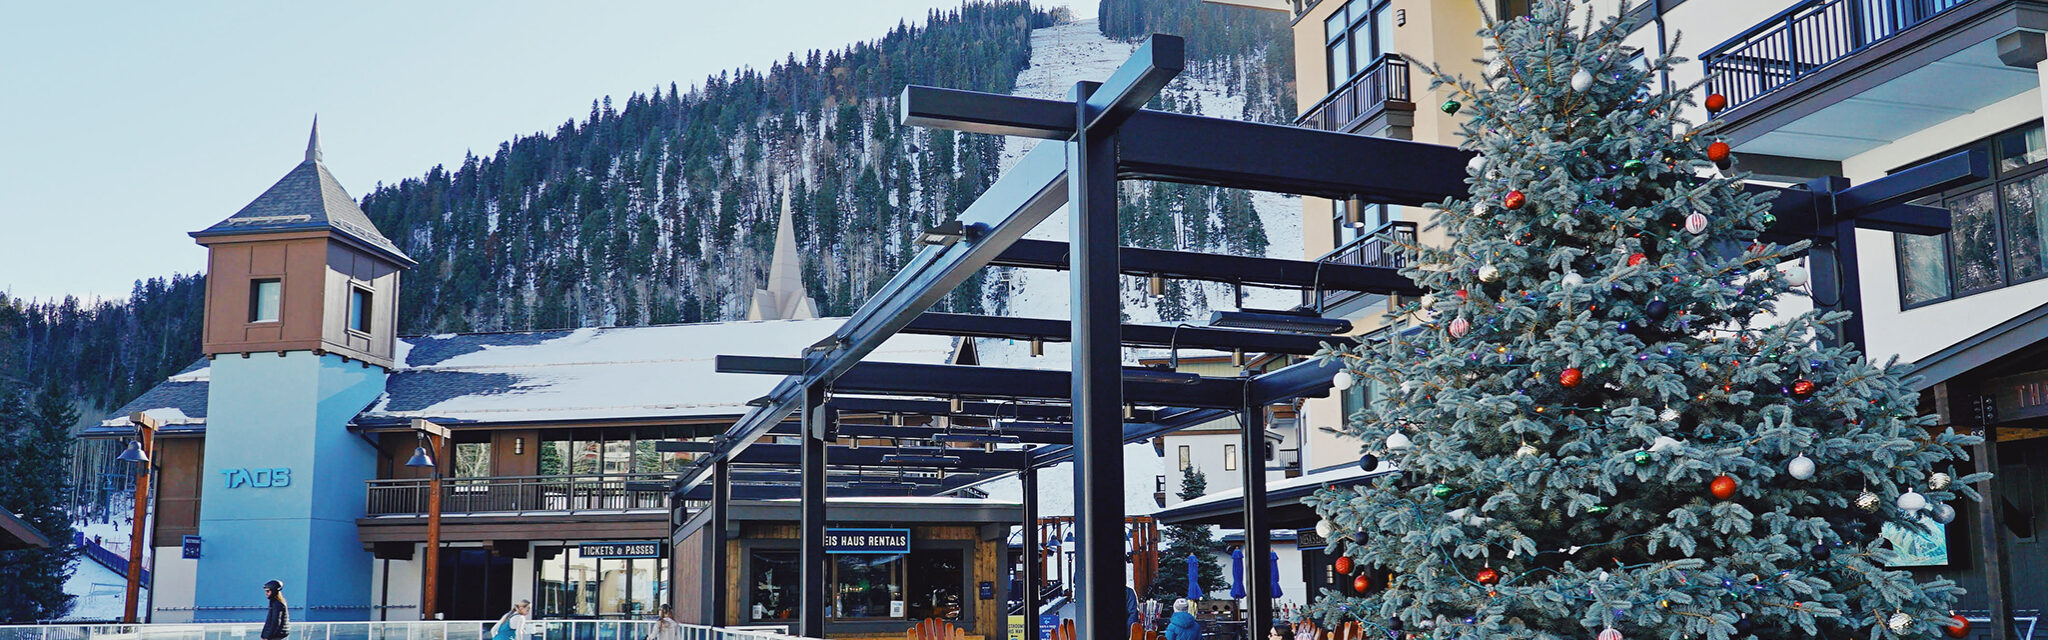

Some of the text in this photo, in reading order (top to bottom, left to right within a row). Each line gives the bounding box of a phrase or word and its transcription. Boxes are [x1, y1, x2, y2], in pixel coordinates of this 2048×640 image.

[219, 467, 291, 488] TAOS
[841, 536, 865, 546] HAUS
[868, 536, 906, 546] RENTALS
[583, 546, 614, 556] TICKETS
[625, 545, 654, 555] PASSES
